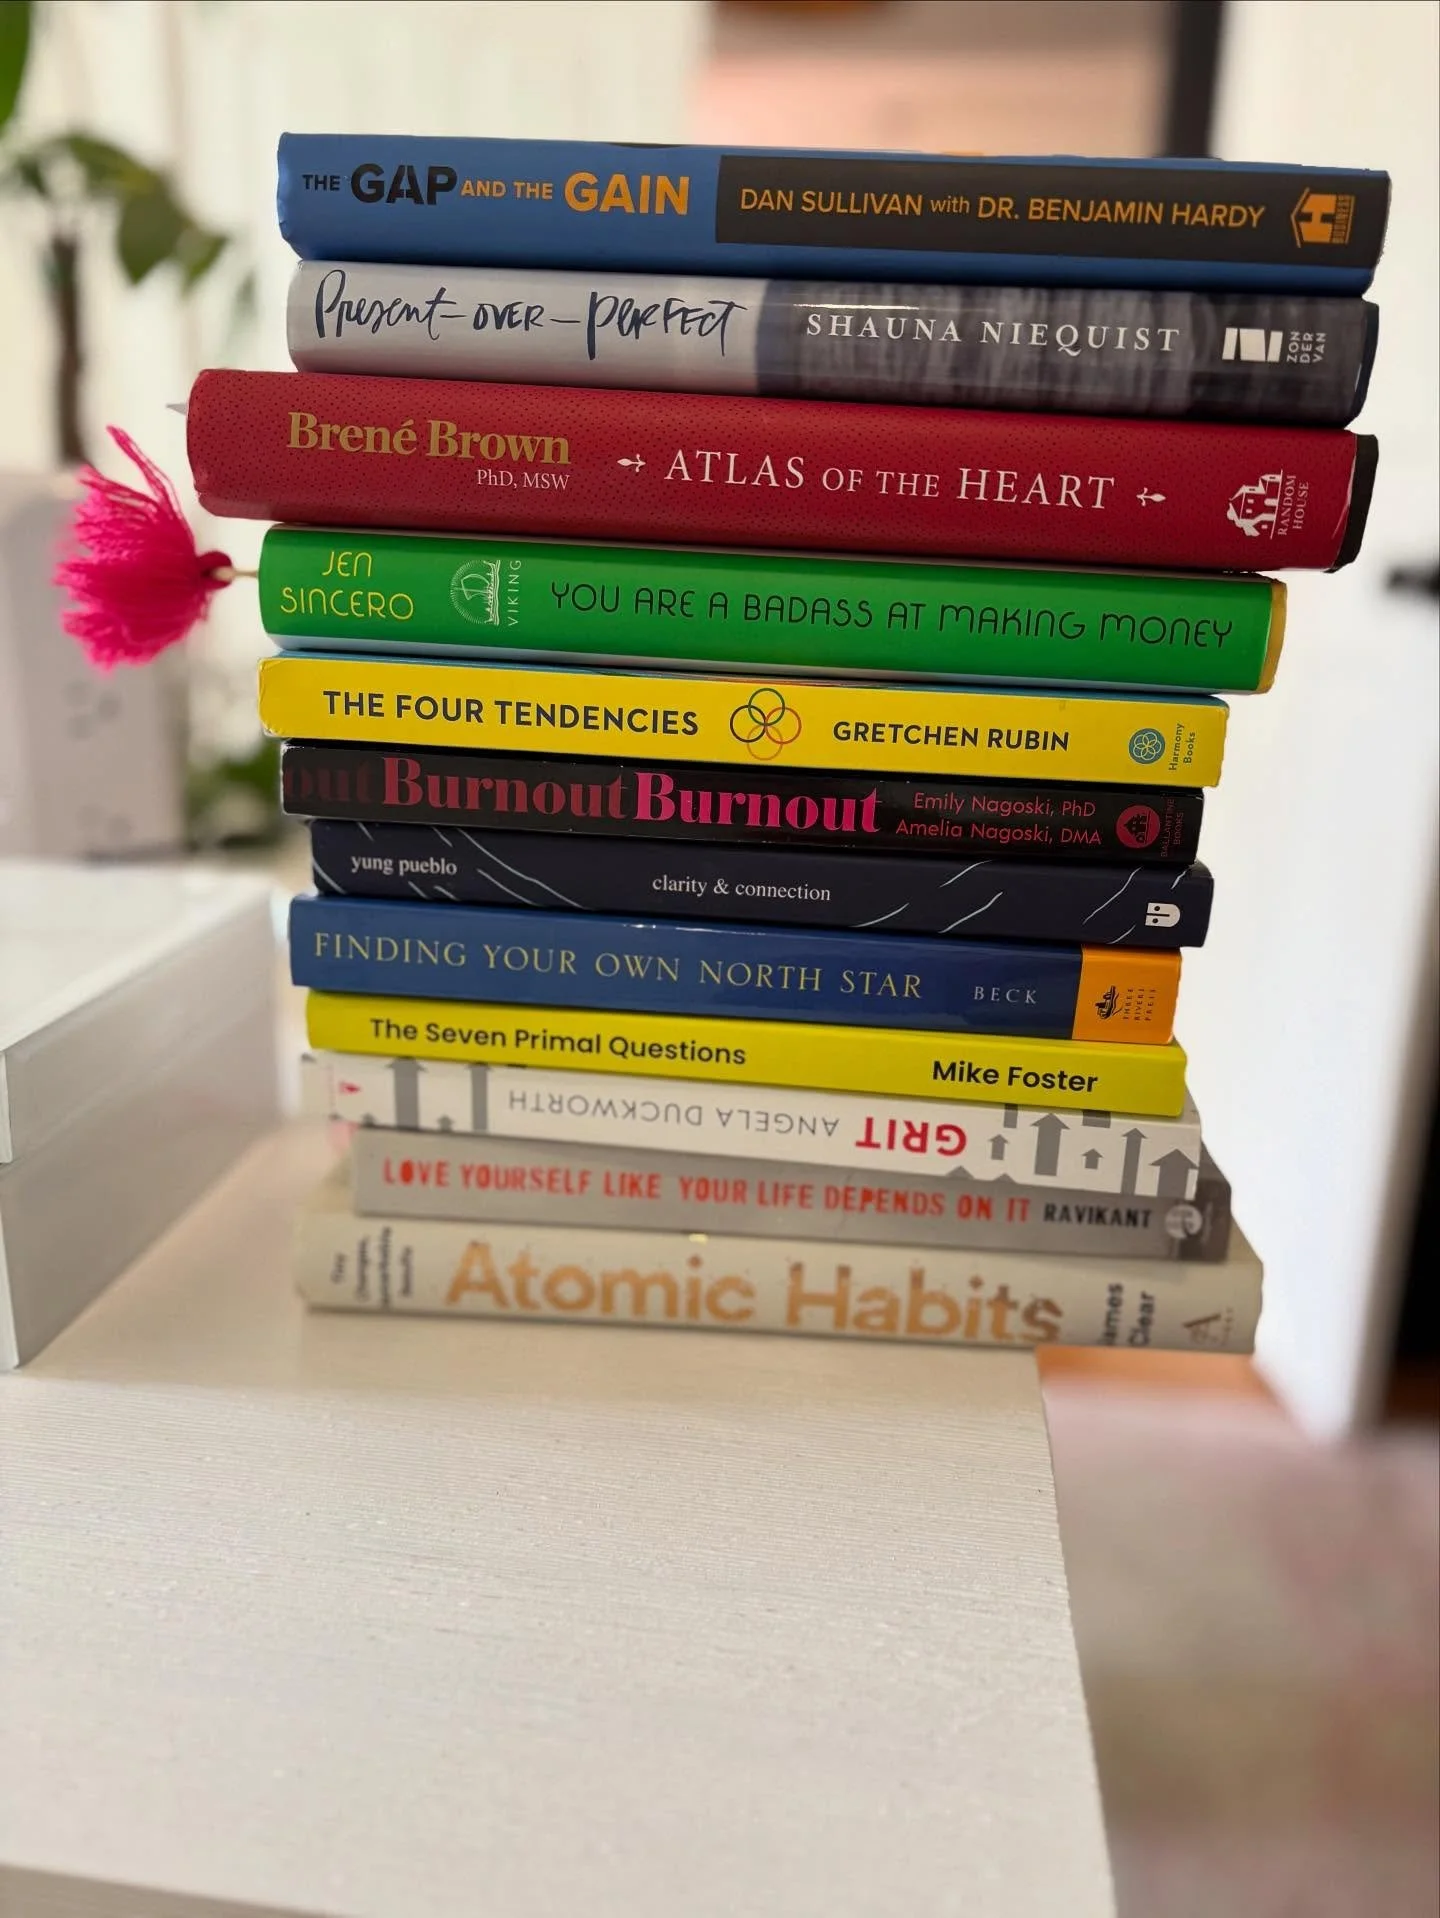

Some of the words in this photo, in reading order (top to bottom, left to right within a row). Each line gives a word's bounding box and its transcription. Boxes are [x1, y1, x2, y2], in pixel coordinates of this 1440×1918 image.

[303, 174, 340, 191] THE
[350, 163, 457, 206] GAP
[461, 179, 505, 198] AND
[514, 181, 553, 200] THE
[565, 172, 690, 216] GAIN
[741, 187, 793, 213] DAN
[801, 190, 922, 217] SULLIVAN
[930, 197, 970, 215] with
[978, 197, 1019, 221] DR.
[1028, 199, 1163, 226] BENJAMIN
[1171, 204, 1264, 230] HARDY
[806, 313, 960, 343] SHAUNA
[980, 321, 1181, 357] NIEQUIST
[1286, 331, 1300, 363] ZON
[1300, 332, 1314, 364] DER
[1313, 332, 1327, 363] VAN
[287, 411, 417, 456] Brené
[426, 420, 571, 465] Brown
[477, 469, 517, 489] PhD,
[523, 471, 570, 491] MSW
[664, 449, 805, 488] ATLAS
[822, 467, 862, 492] OF
[876, 470, 940, 498] THE
[957, 467, 1114, 509] HEART
[1278, 475, 1296, 536] RANDOM
[1292, 482, 1309, 529] HOUSE
[322, 551, 372, 578] JEN
[280, 587, 414, 620] SINCERO
[508, 560, 521, 627] VIKING
[551, 581, 620, 613] YOU
[635, 587, 695, 618] ARE
[708, 591, 729, 620] A
[743, 593, 873, 628] BADASS
[888, 602, 926, 630] AT
[938, 603, 1086, 640] MAKING
[1100, 612, 1233, 648] MONEY
[323, 690, 384, 717] THE
[396, 695, 483, 724] FOUR
[494, 700, 698, 735] TENDENCIES
[833, 721, 978, 749] GRETCHEN
[988, 726, 1070, 752] RUBIN
[1168, 723, 1184, 771] Harmony
[1183, 732, 1196, 764] Books
[382, 756, 627, 820] Burnout
[633, 771, 883, 833] Burnout
[914, 792, 965, 813] Emily
[972, 795, 1054, 818] Nagoski,
[1062, 801, 1096, 818] PhD
[896, 819, 963, 838] Amelia
[970, 823, 1054, 845] Nagoski,
[1060, 828, 1102, 845] DMA
[351, 855, 394, 876] yung
[399, 857, 457, 877] pueblo
[652, 874, 707, 897] clarity
[713, 878, 729, 895] &
[735, 883, 831, 901] connection
[314, 932, 466, 966] FINDING
[483, 944, 577, 974] YOUR
[595, 953, 680, 982] OWN
[700, 960, 822, 992] NORTH
[840, 970, 922, 999] STAR
[973, 986, 1037, 1005] BECK
[370, 1018, 418, 1041] The
[426, 1022, 507, 1048] Seven
[515, 1029, 601, 1054] Primal
[609, 1036, 746, 1065] Questions
[933, 1060, 1000, 1085] Mike
[1007, 1066, 1099, 1093] Foster
[508, 1090, 703, 1127] DUCKWORTH
[716, 1107, 839, 1138] ANGELA
[855, 1116, 967, 1157] GRIT
[382, 1158, 451, 1188] LOVE
[460, 1163, 592, 1197] YOURSELF
[604, 1170, 661, 1200] LIKE
[679, 1175, 748, 1206] YOUR
[757, 1180, 812, 1210] LIFE
[824, 1185, 944, 1217] DEPENDS
[956, 1194, 993, 1222] ON
[1006, 1198, 1030, 1224] IT
[1043, 1202, 1152, 1230] RAVIKANT
[443, 1239, 757, 1324] Atomic
[784, 1262, 1064, 1346] Habits
